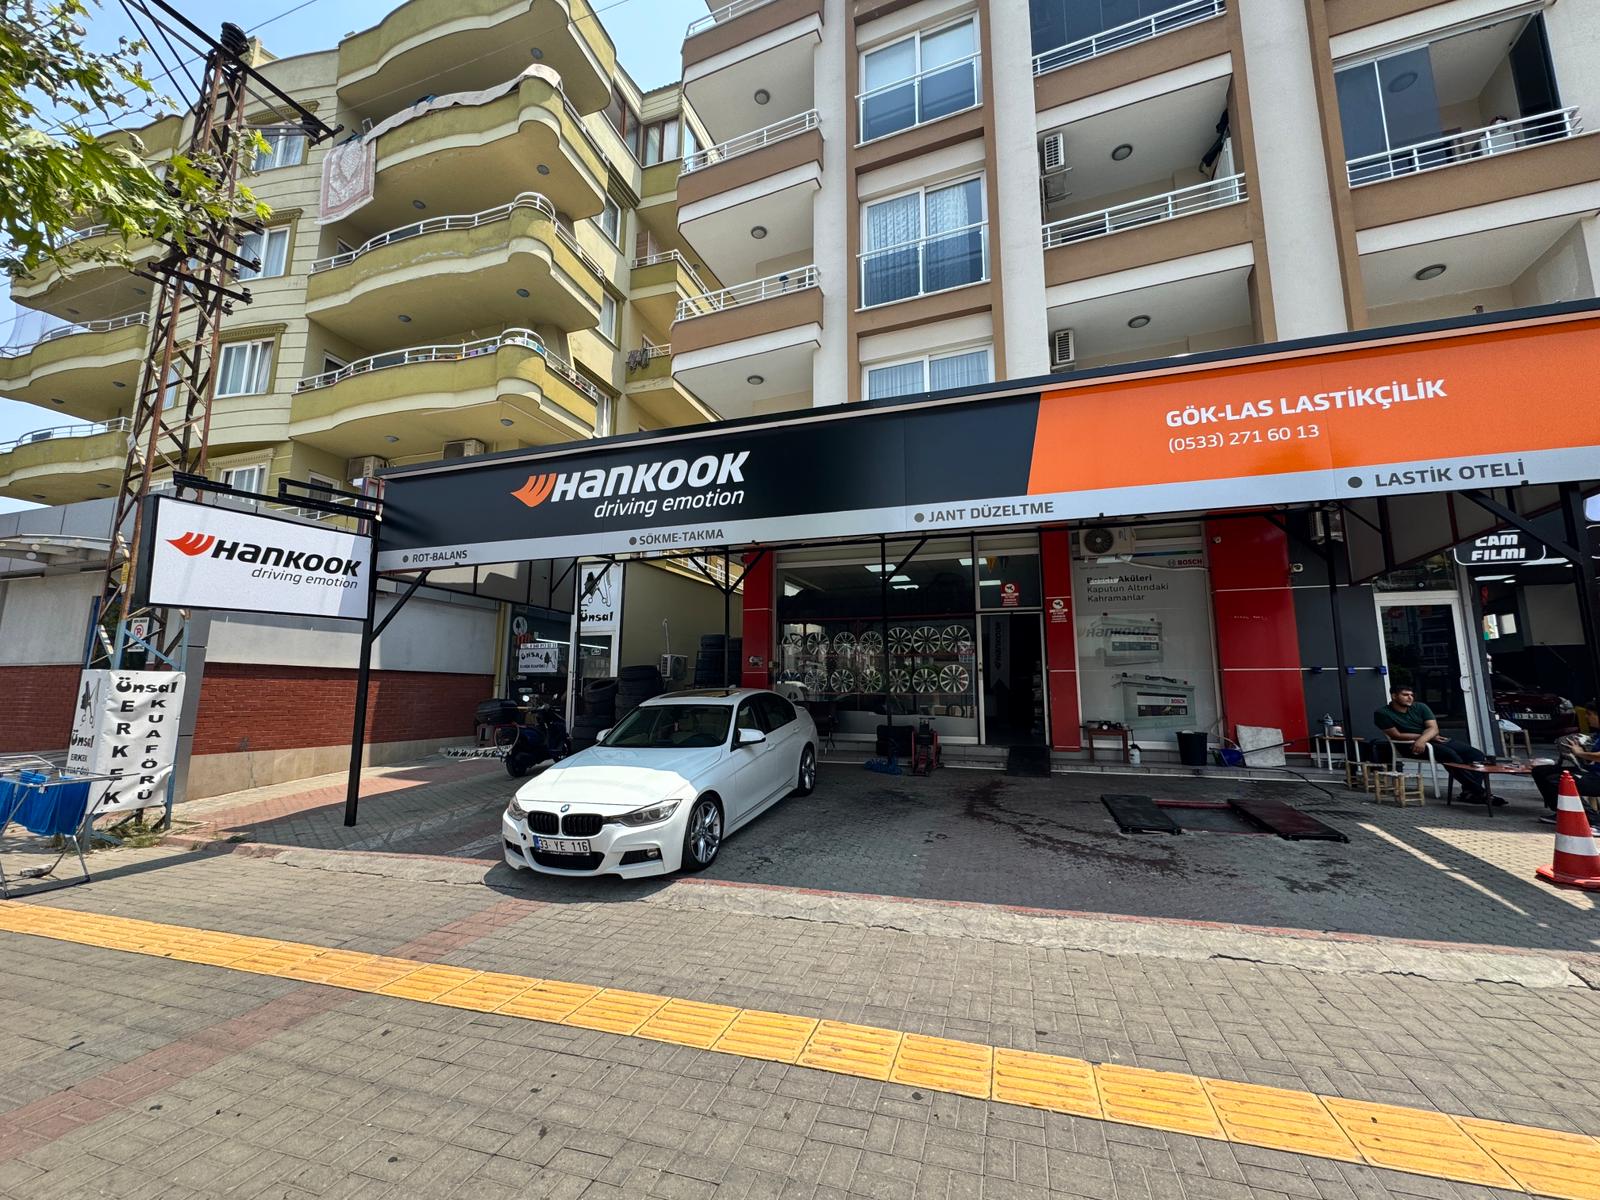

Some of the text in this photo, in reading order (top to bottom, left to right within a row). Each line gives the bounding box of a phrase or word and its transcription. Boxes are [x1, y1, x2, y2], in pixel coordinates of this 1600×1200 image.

[1166, 379, 1447, 427] GÖK-LAS LASTİKÇİLİK
[1167, 424, 1319, 453] (0533) 271 60 13
[1375, 459, 1526, 488] LASTİK OTELİ
[594, 490, 745, 519] driving emotion
[928, 501, 1055, 523] JANT DÜZELTME
[639, 528, 725, 546] SÖKME-TAKMA
[1474, 534, 1519, 547] CAM
[411, 549, 469, 564] ROT-BALANS
[1471, 548, 1526, 561] FILMI
[251, 567, 358, 589] driving emotion
[1118, 573, 1152, 583] Aküleri
[1087, 582, 1169, 594] Kaputun Altındaki
[1087, 594, 1145, 602] Kahramanlar
[116, 676, 178, 694] Ünsal
[539, 839, 588, 852] 33 YE 116
